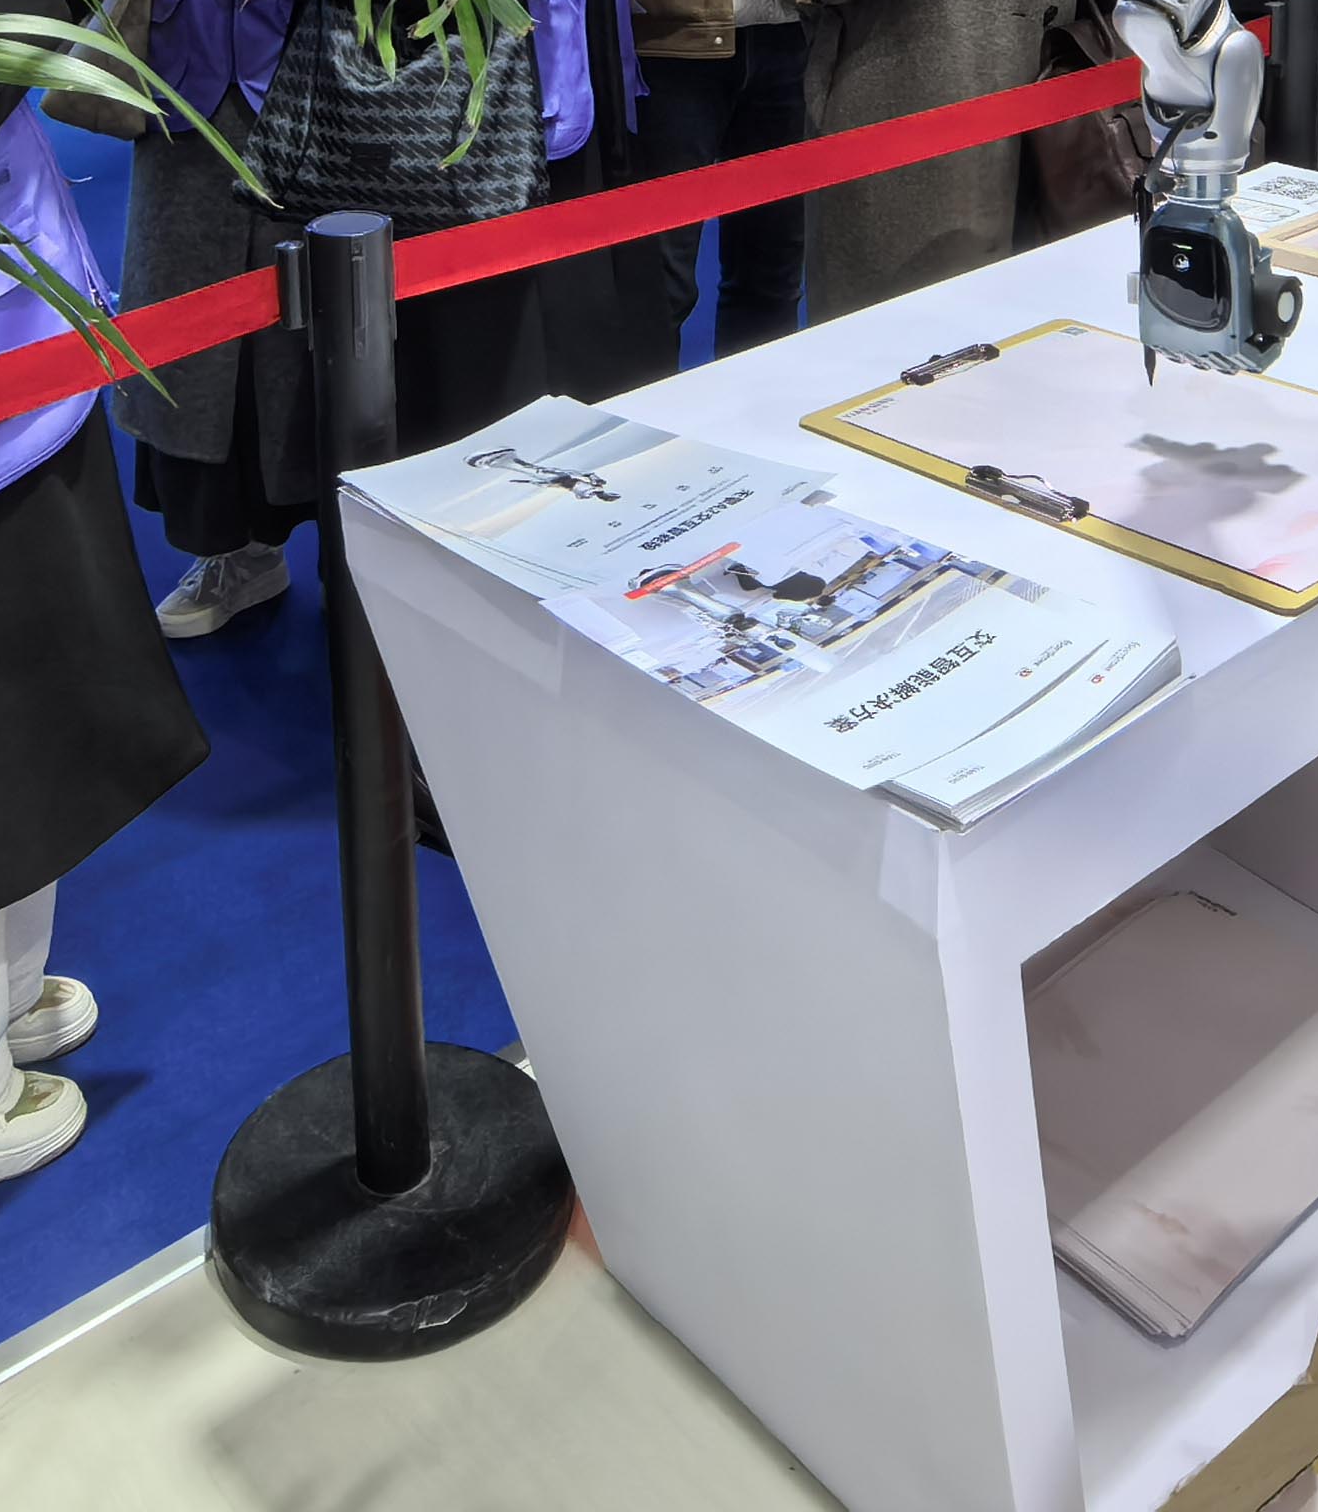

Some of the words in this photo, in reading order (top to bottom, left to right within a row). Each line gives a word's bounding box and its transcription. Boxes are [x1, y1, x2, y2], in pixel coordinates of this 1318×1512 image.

[823, 628, 997, 733] 交互智能解决方案
